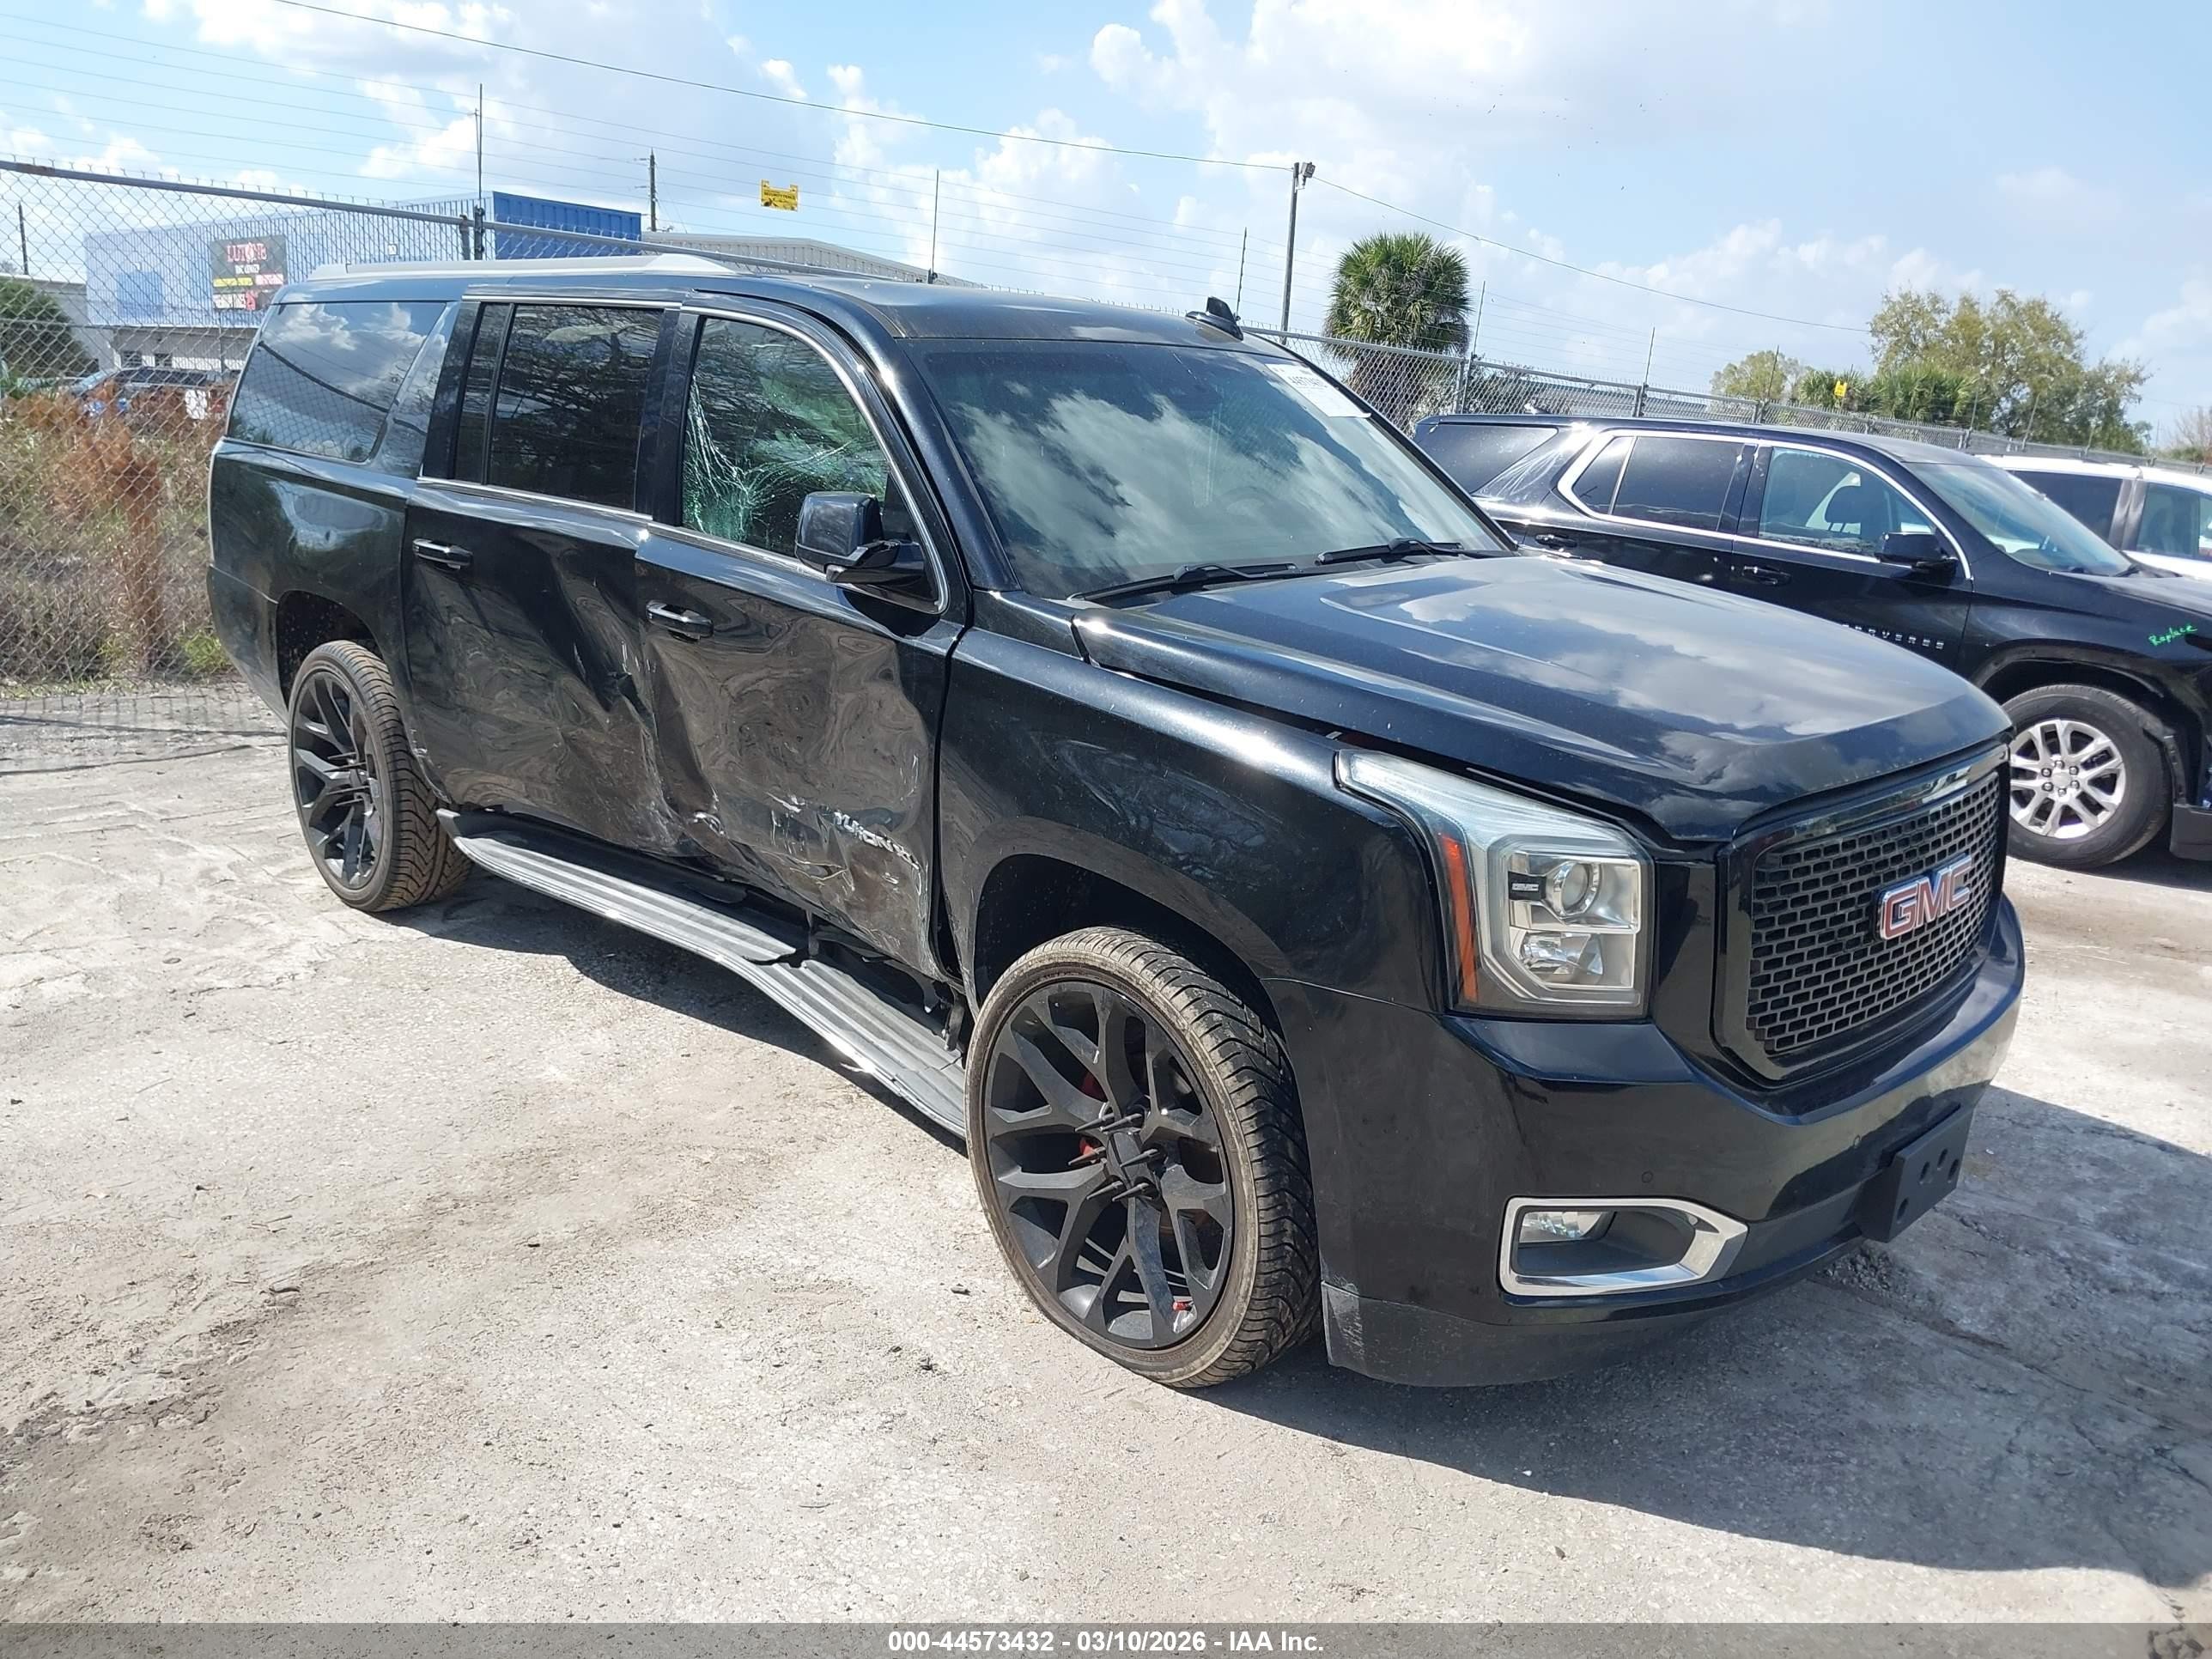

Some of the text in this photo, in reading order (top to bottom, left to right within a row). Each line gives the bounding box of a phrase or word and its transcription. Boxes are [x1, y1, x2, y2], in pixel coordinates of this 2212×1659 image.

[1841, 623, 1945, 649] AVERSE
[2148, 624, 2198, 646] Replace
[1880, 854, 1972, 940] GMC
